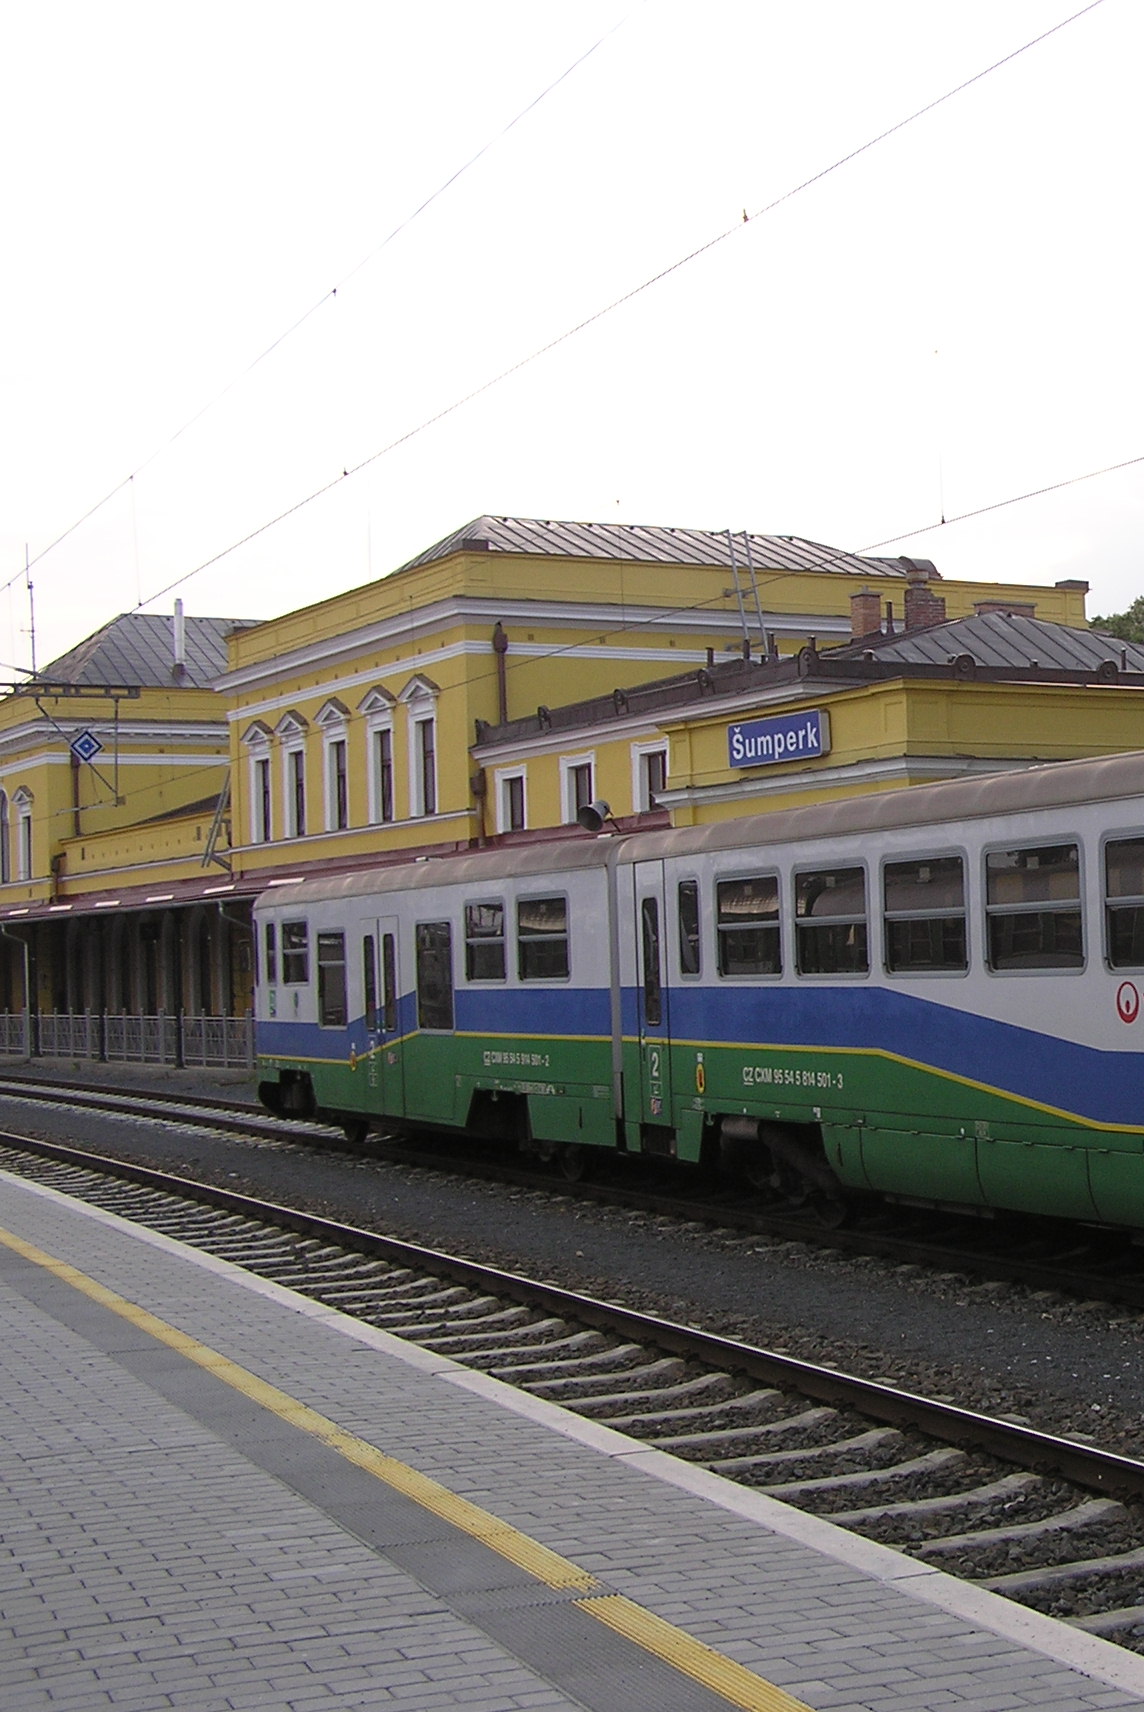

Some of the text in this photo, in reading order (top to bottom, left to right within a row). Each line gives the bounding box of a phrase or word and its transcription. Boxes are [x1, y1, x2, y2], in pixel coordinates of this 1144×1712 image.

[732, 721, 819, 760] Šumperk
[651, 1052, 660, 1077] 2
[743, 1067, 754, 1082] CZ
[784, 1069, 794, 1084] 54
[795, 1070, 801, 1085] 5
[816, 1072, 831, 1088] 501
